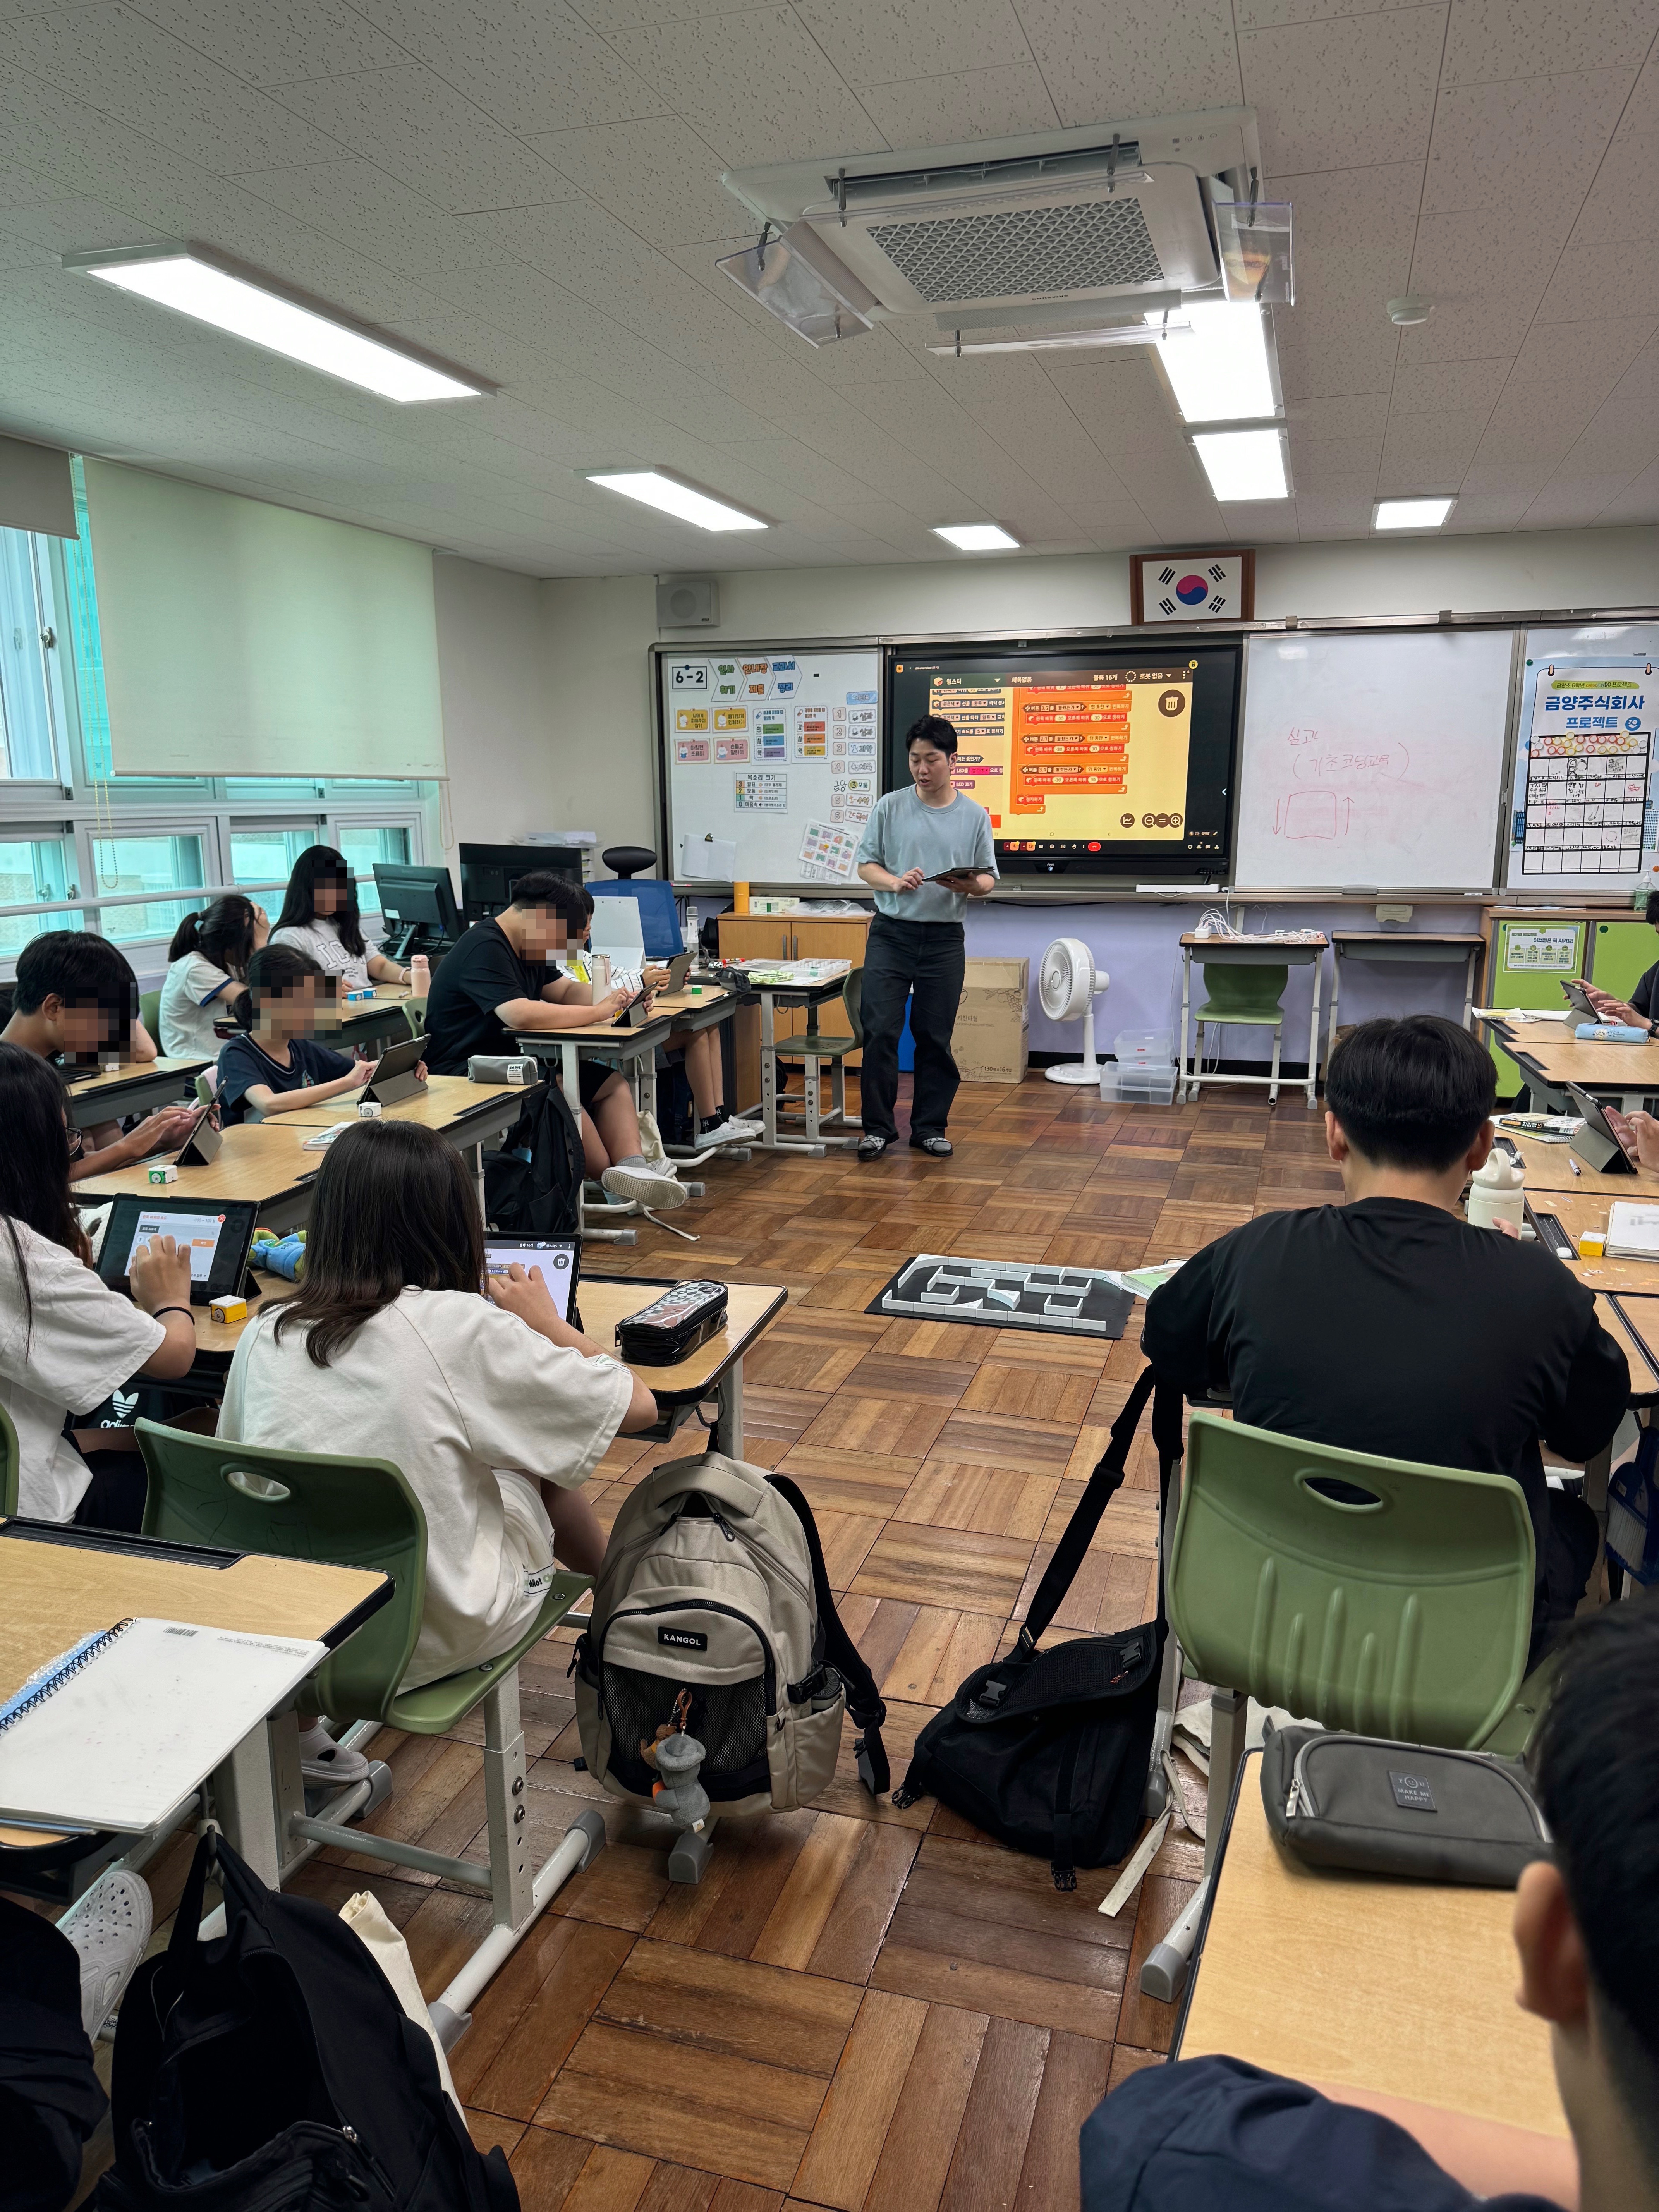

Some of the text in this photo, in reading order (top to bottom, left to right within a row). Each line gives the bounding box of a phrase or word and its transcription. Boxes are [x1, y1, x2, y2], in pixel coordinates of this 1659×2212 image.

[718, 665, 735, 675] 인사
[742, 663, 768, 675] 안내장
[772, 661, 795, 672] 교과서
[720, 685, 736, 694] 하기
[749, 684, 764, 694] 제출
[778, 682, 793, 693] 정리
[1545, 695, 1645, 711] 금양주식회사
[837, 709, 842, 718] 1
[1566, 716, 1618, 728] 프로젝트
[836, 727, 842, 736] 2
[1287, 727, 1318, 745] 실과
[836, 744, 842, 752] 3
[835, 763, 841, 771] 4
[835, 796, 841, 804] 5
[835, 812, 840, 820] 6
[664, 1633, 701, 1645] KANGOL
